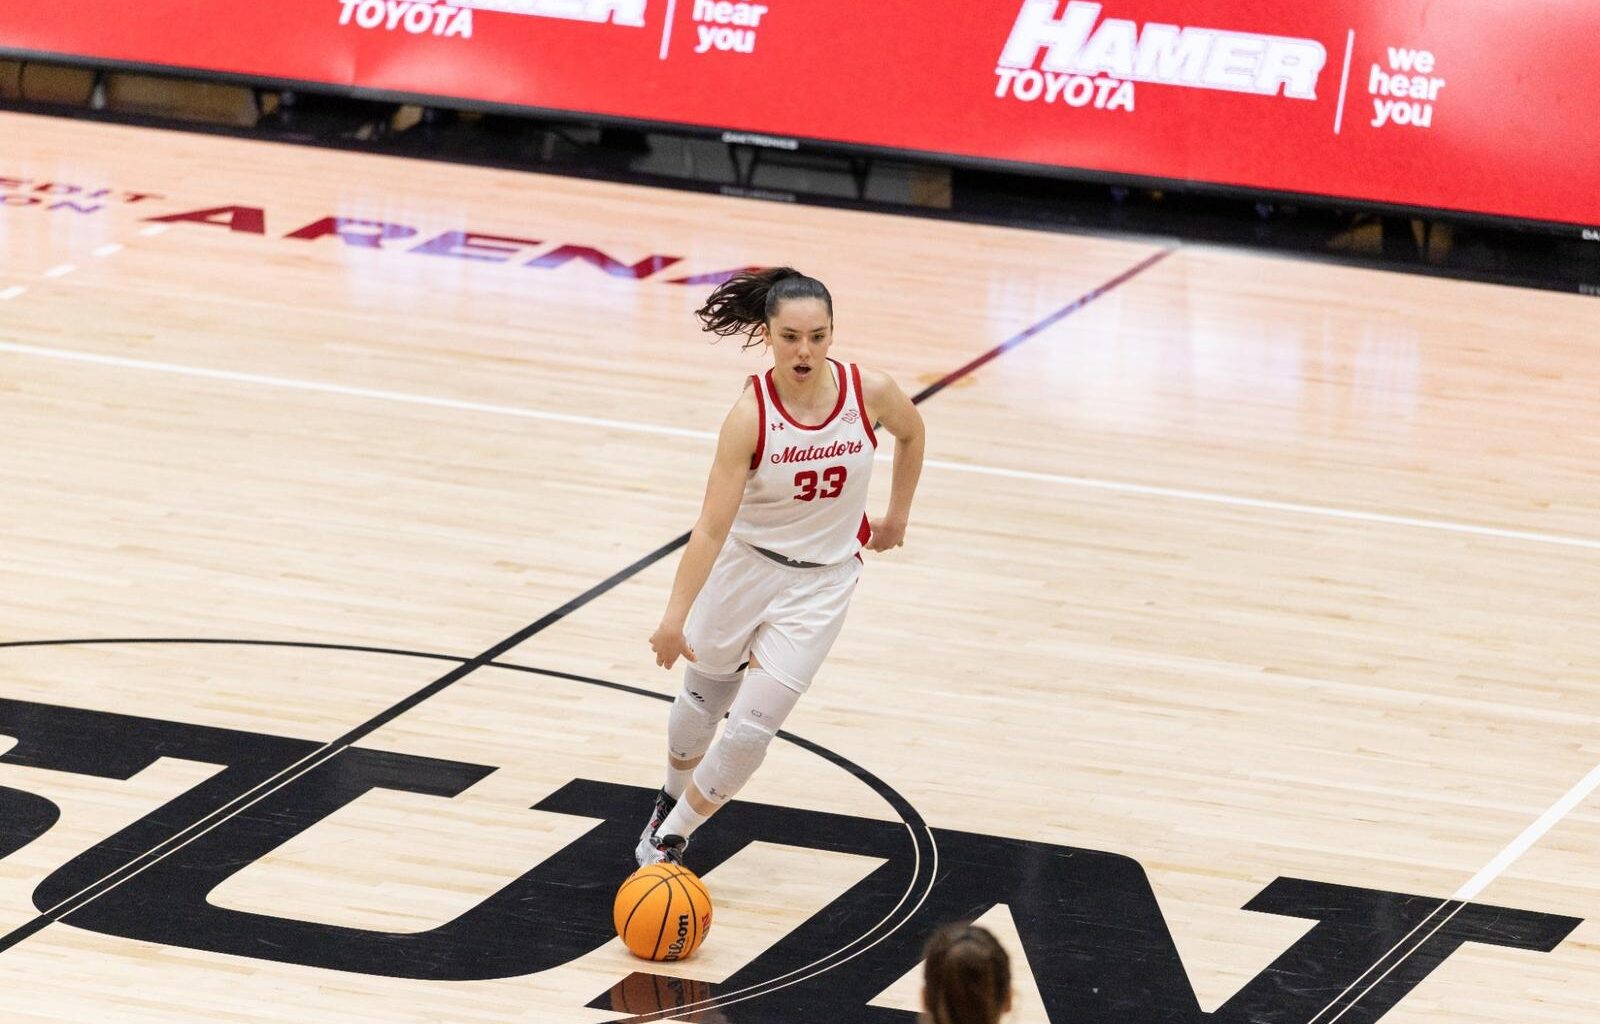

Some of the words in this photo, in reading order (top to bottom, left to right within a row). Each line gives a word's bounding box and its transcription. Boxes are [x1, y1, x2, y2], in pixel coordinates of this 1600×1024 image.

[338, 0, 473, 39] TOYOTA
[692, 0, 768, 27] hear
[694, 25, 756, 54] you
[997, 0, 1327, 101] HAMER
[1387, 46, 1435, 74] we
[994, 67, 1136, 112] TOYOTA
[1368, 63, 1445, 101] hear
[1370, 97, 1433, 129] you
[770, 440, 863, 464] Matadors
[793, 465, 848, 502] 33
